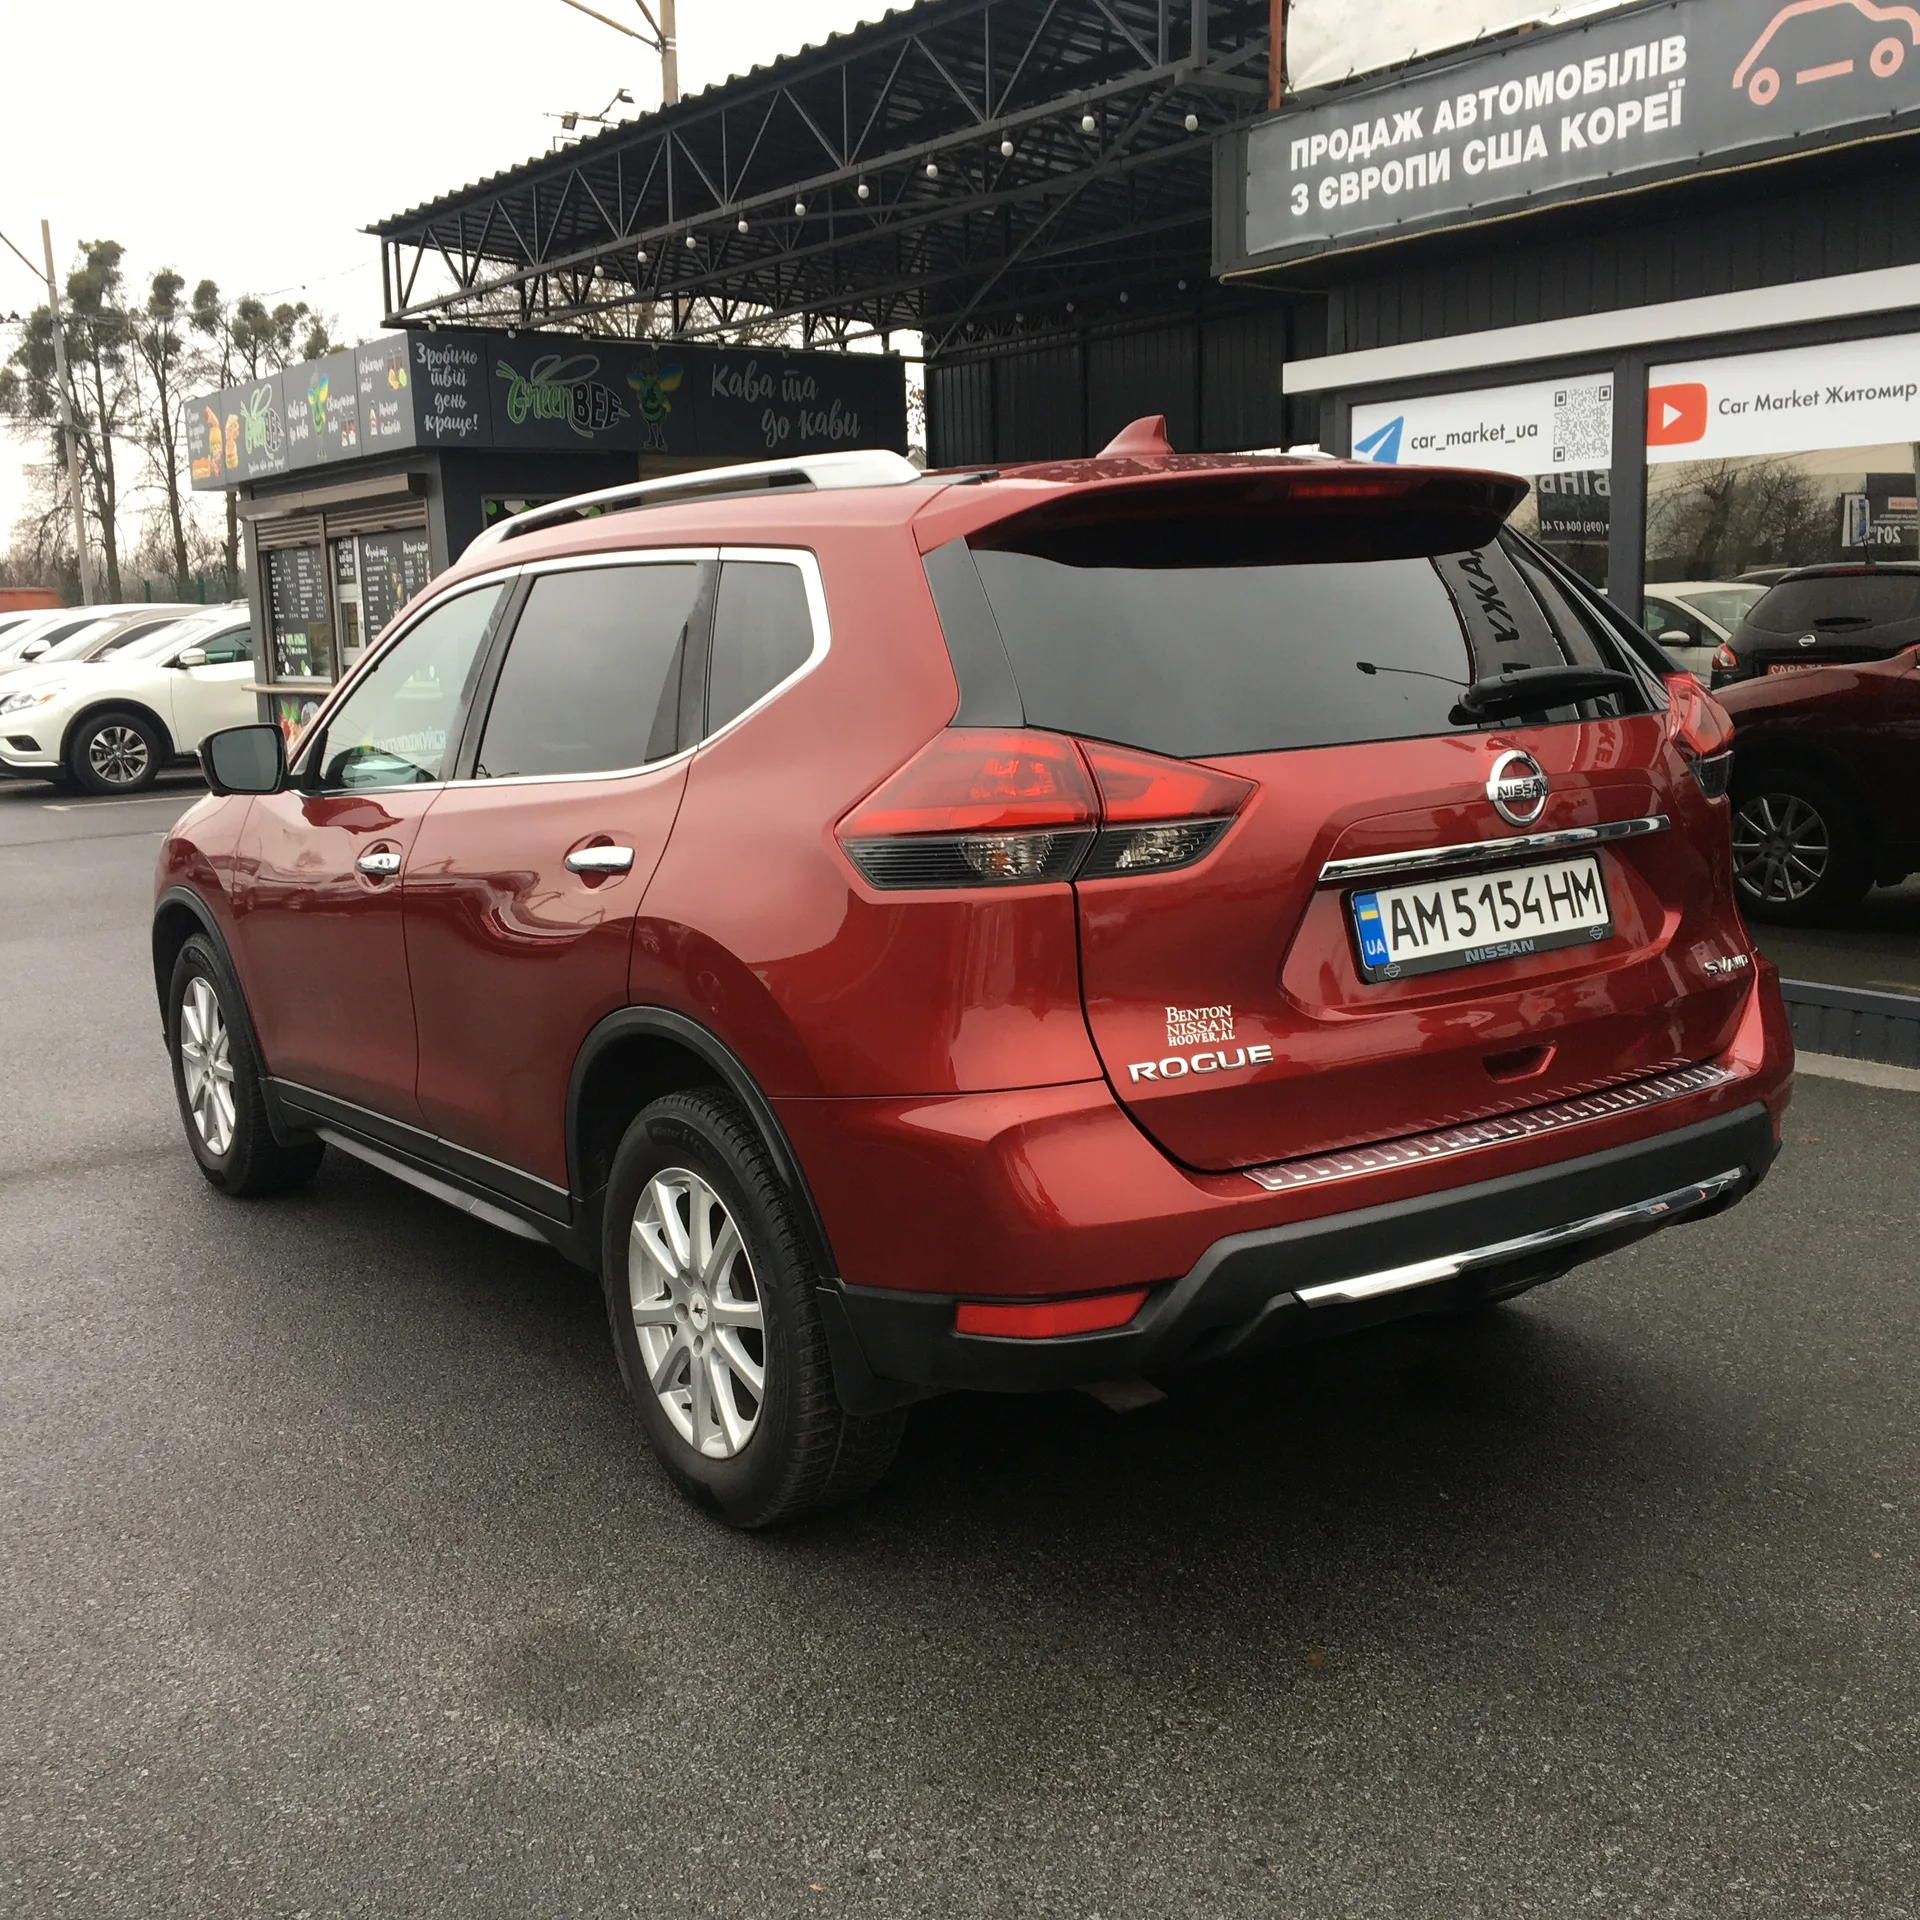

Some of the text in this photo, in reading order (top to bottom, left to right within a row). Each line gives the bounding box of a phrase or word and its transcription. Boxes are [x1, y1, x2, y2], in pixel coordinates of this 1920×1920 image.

[1290, 35, 1687, 172] ПРОДАЖ АВТОМОБІЛІВ
[1290, 79, 1686, 216] З ЄВРОПИ США КОРЕЇ
[416, 342, 478, 372] Зробимо
[431, 365, 467, 388] твій
[711, 360, 819, 403] Кава та
[434, 392, 467, 414] день
[1718, 382, 1918, 416] Car Market Житомир
[424, 414, 478, 439] краще!
[762, 399, 861, 448] до кави
[1410, 421, 1539, 452] car_market_ua
[1497, 782, 1548, 799] NISSAN
[1366, 940, 1386, 956] UA
[1465, 939, 1535, 963] NISSAN
[1165, 1005, 1232, 1024] BENTON
[1166, 1018, 1234, 1037] NISSAN
[1127, 1044, 1274, 1084] ROGUE
